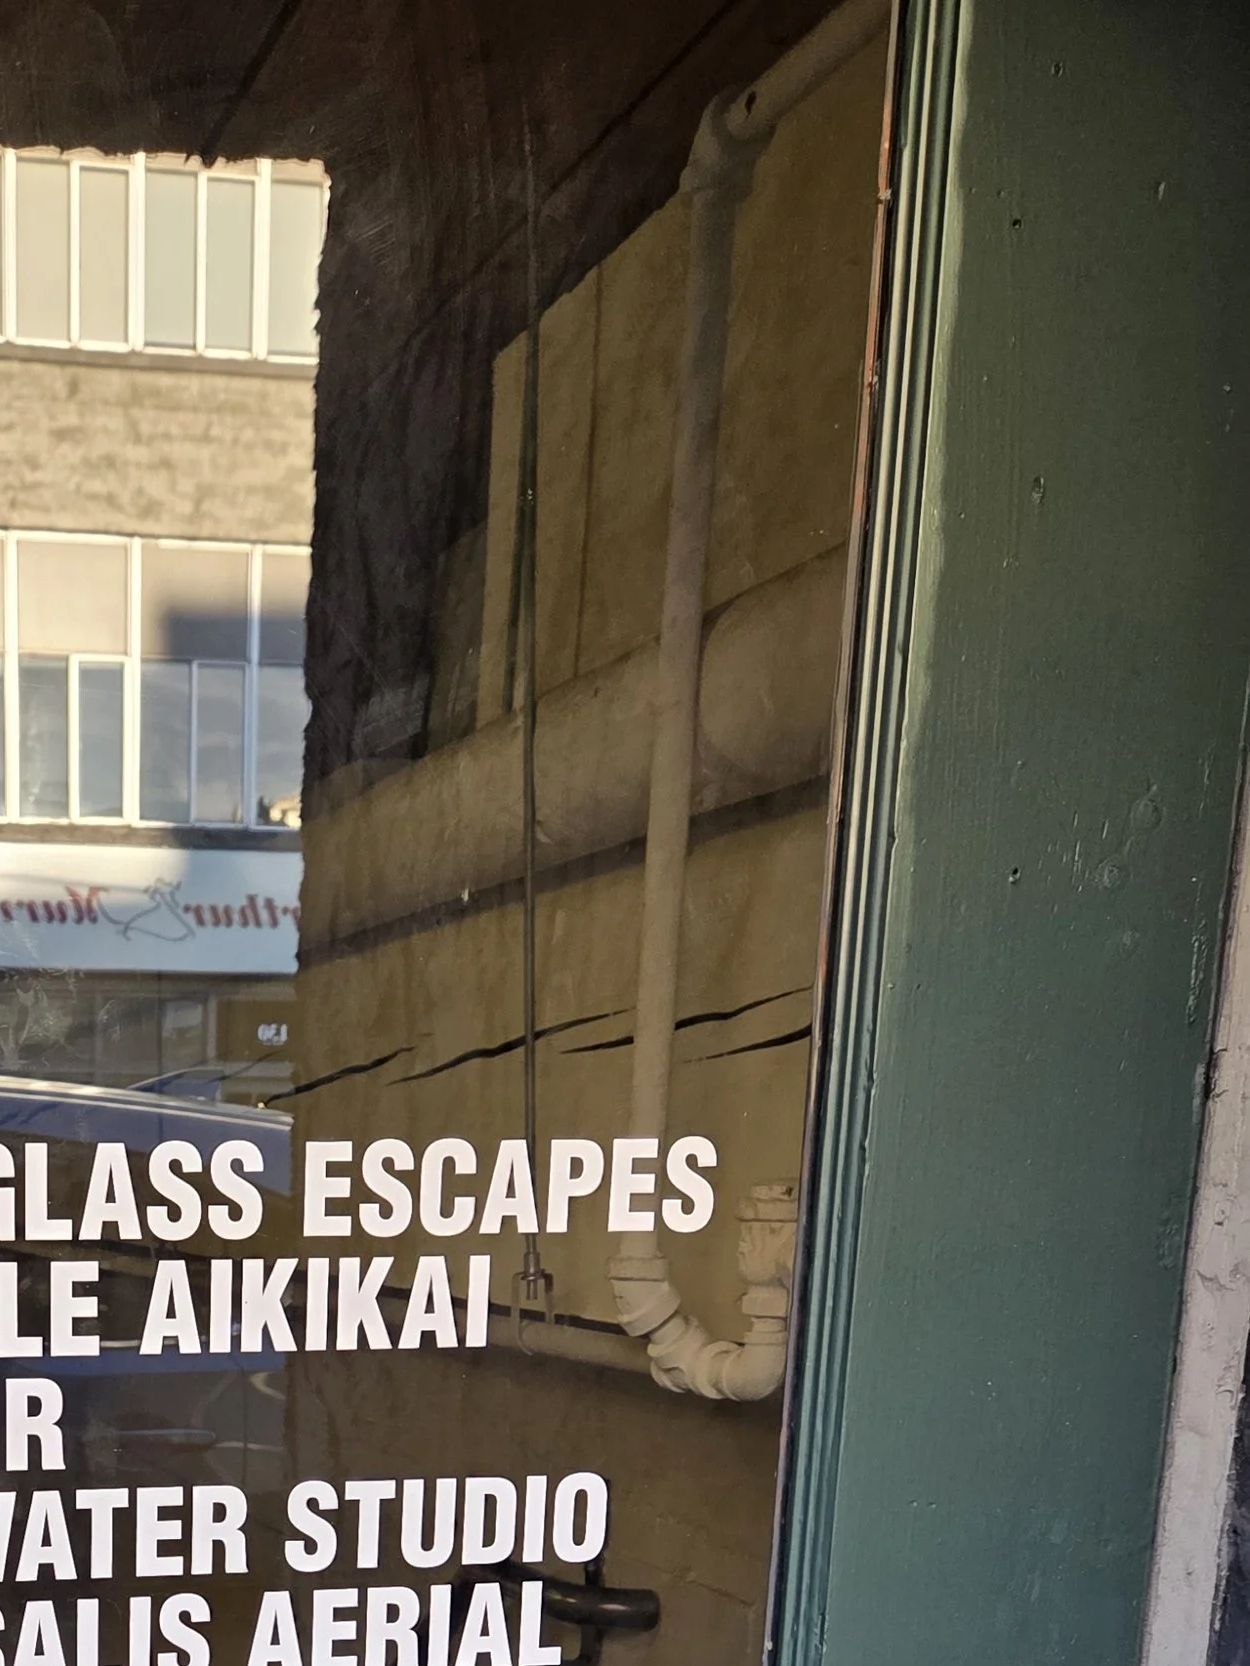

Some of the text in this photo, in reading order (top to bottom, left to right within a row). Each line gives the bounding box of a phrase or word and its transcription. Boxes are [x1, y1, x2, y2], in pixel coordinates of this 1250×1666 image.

[303, 1136, 717, 1238] ESCAPES
[139, 1254, 491, 1355] AIKIKAI
[284, 1472, 608, 1573] STUDIO
